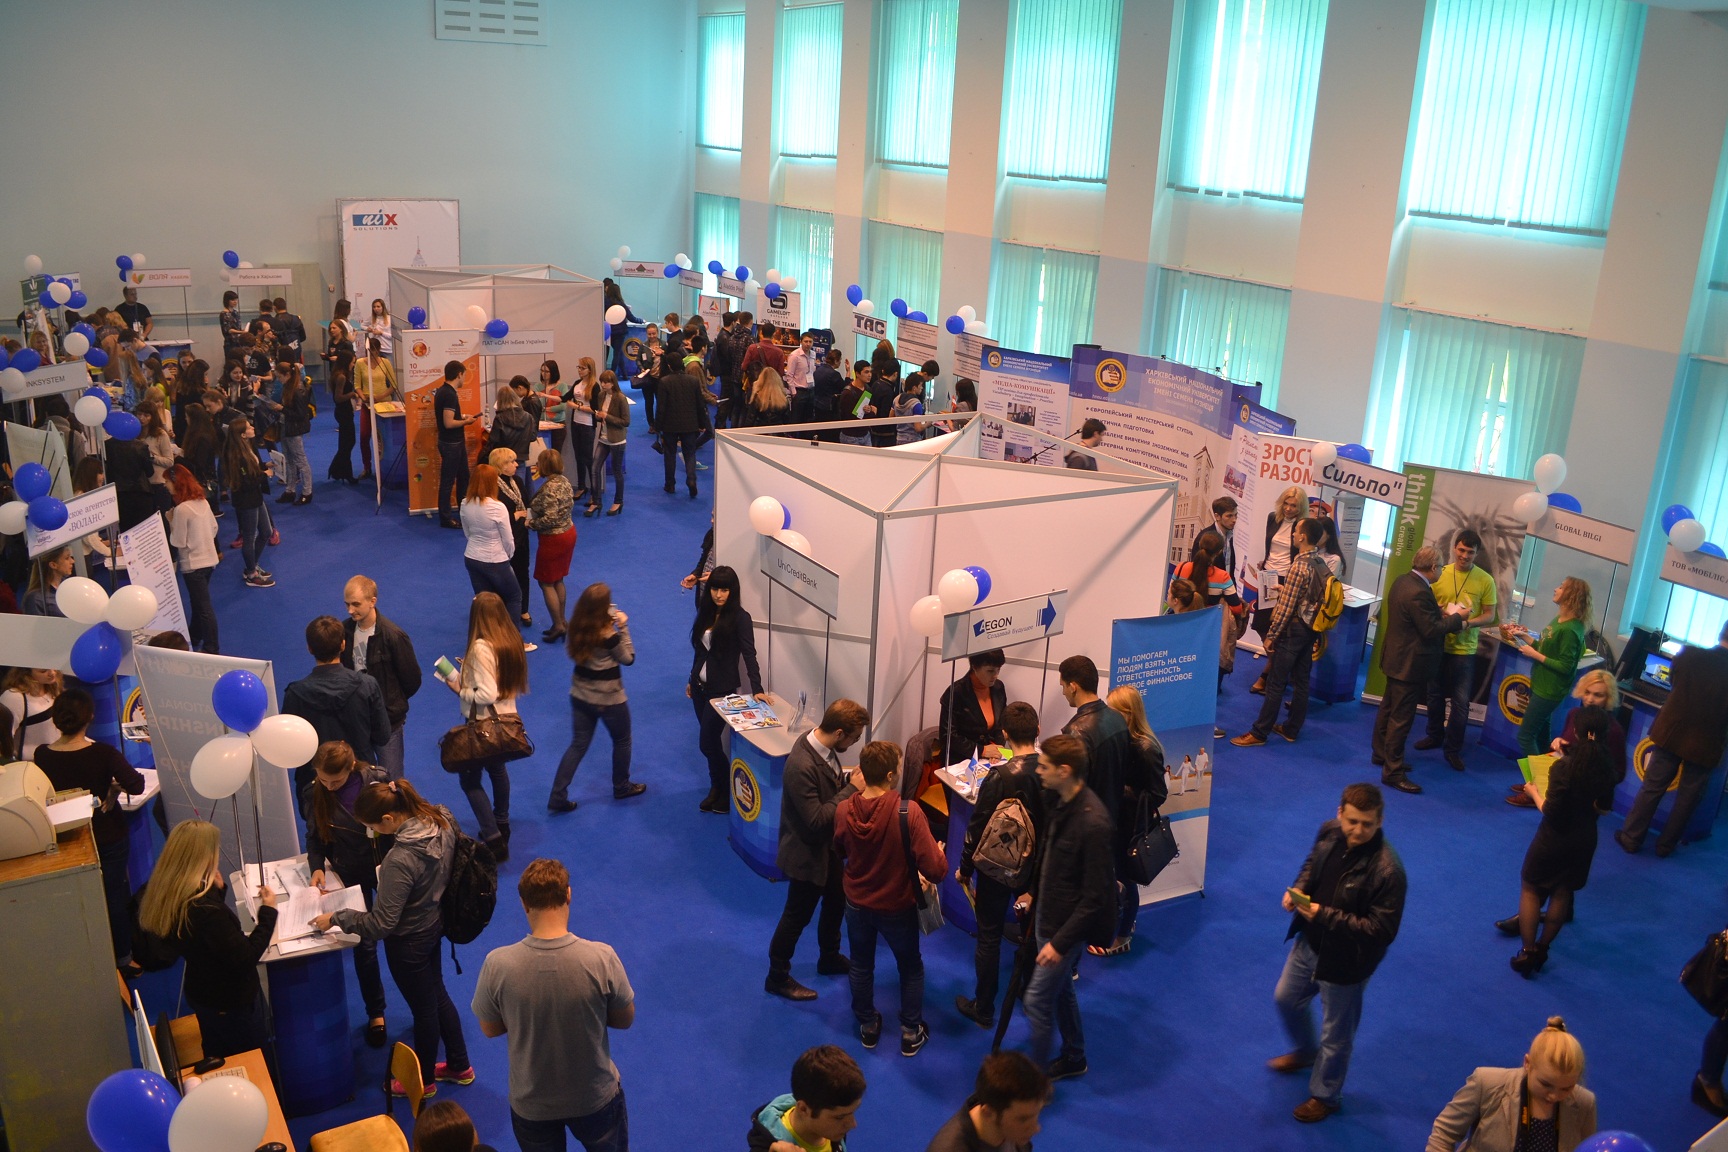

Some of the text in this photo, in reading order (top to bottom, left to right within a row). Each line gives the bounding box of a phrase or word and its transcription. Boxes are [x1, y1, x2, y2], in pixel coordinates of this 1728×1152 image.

[766, 308, 791, 317] GAMELOFT
[772, 319, 781, 327] THE
[782, 321, 797, 329] TEAM!
[1145, 368, 1224, 397] ХАРКІВСЬКИЙ НАЦІОНАЛЬНИЙ
[1148, 377, 1220, 405] ЕКОНОМІЧНИЙ УНІВЕРСИТЕТ
[1153, 387, 1172, 397] ІМЕНІ
[1173, 392, 1194, 404] СЕМЕНА
[1194, 399, 1214, 412] КУЗНЕЦЯ
[1090, 406, 1133, 419] ЄВРОПЕЙСЬКИЙ
[1136, 415, 1174, 429] МАГІСТЕРСЬКИЙ
[1123, 423, 1155, 435] ПІДГОТОВКА
[1124, 435, 1151, 446] ВИВЧЕННЯ
[1152, 442, 1180, 454] ІНОЗЕМНИХ
[1160, 456, 1188, 469] ПІДГОТОВКА
[1262, 442, 1313, 467] ЗРОСТ
[1149, 465, 1171, 476] УСПІШНА
[69, 495, 117, 520] ское агентство
[1401, 473, 1426, 526] think
[1395, 525, 1406, 557] creative
[1406, 527, 1416, 551] global
[1555, 522, 1602, 542] GLOBAL BILGI
[1671, 560, 1687, 571] ТОВ
[979, 616, 1013, 632] AEGON
[1116, 654, 1197, 674] ЛЮДЯМ ВЗЯТЬ НА СЕБЯ
[1117, 650, 1168, 665] МЫ ПОМОГАЕМ
[1116, 665, 1181, 683] ОТВЕТСТВЕННОСТЬ
[1146, 672, 1193, 686] ФИНАНСОВОЕ
